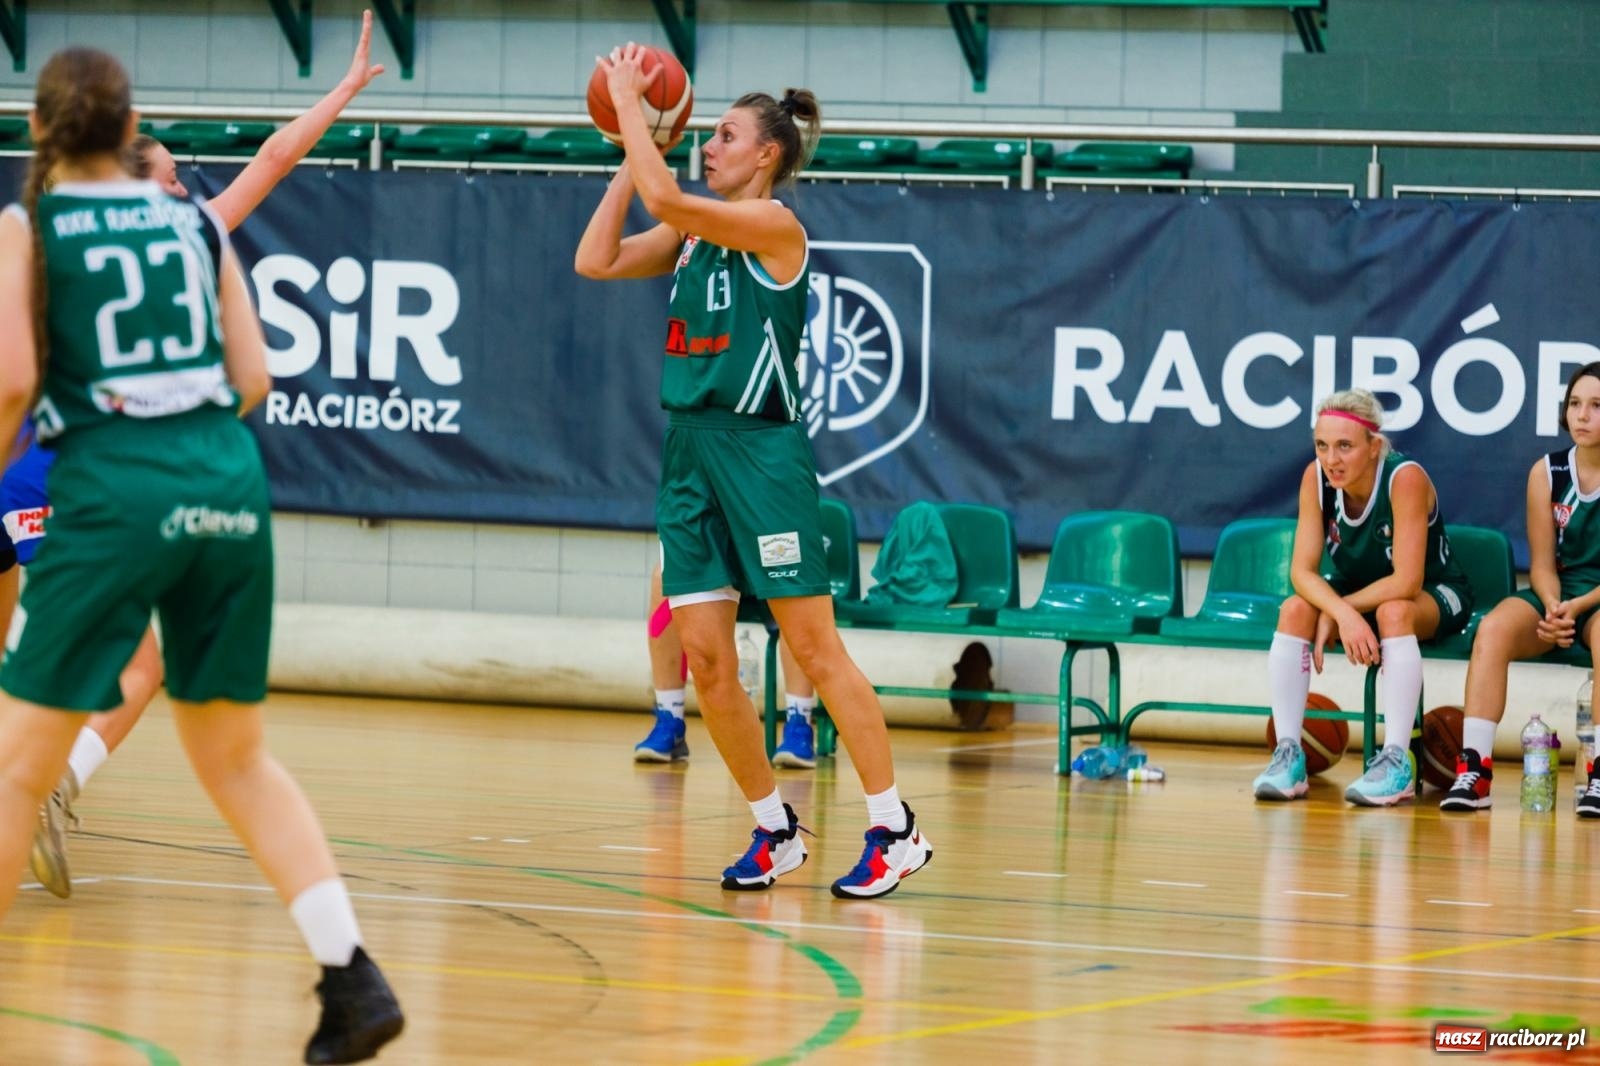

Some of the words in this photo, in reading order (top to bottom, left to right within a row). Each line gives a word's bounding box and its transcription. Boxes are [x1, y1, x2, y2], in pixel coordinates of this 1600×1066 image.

[84, 240, 207, 368] 23
[707, 269, 732, 312] 13
[266, 387, 461, 434] RACIBÓRZ
